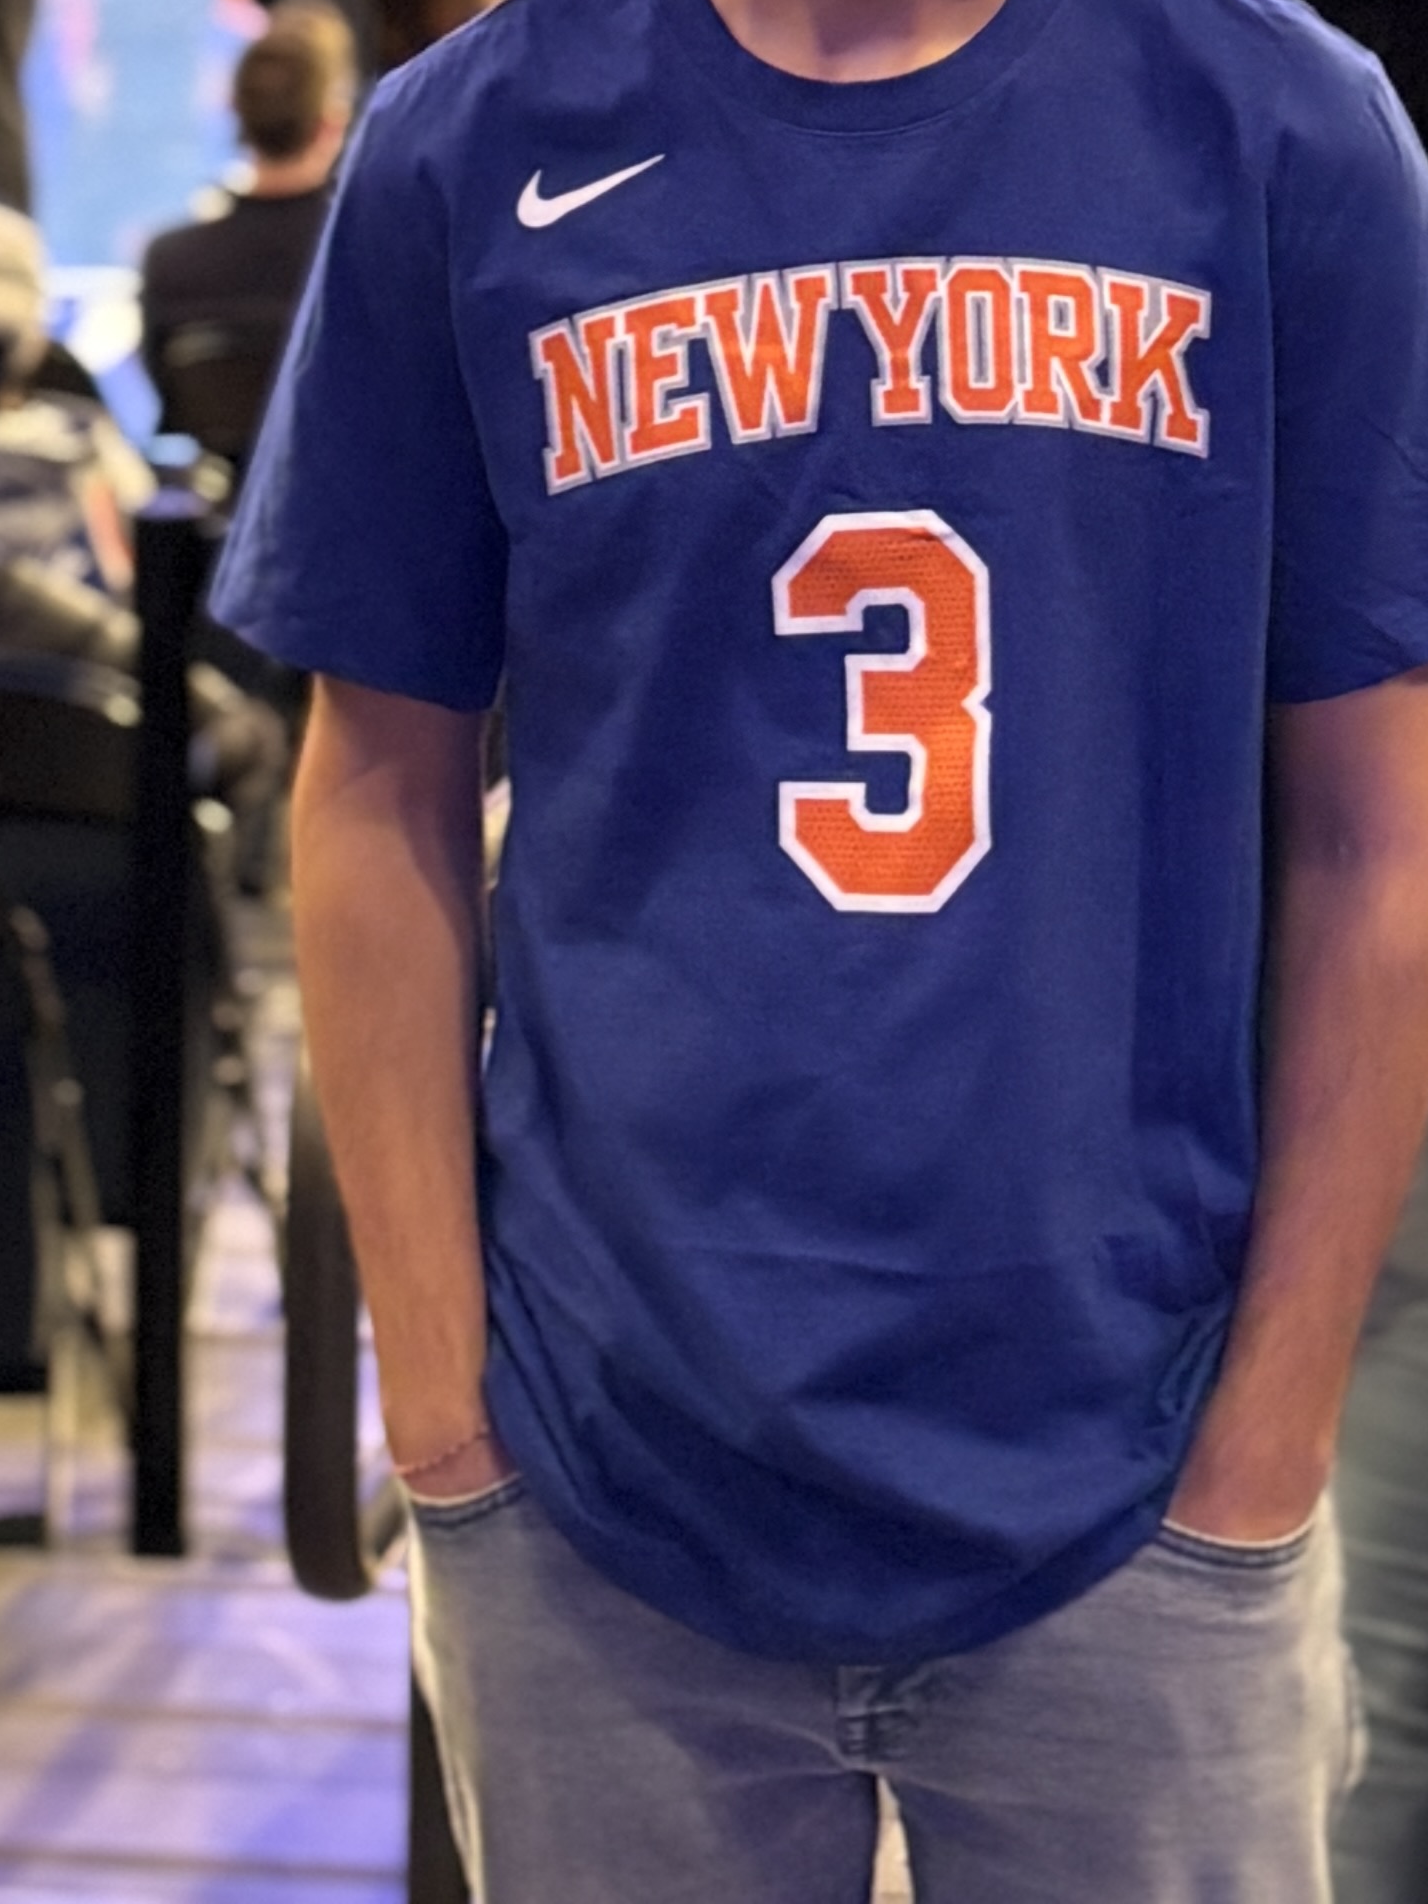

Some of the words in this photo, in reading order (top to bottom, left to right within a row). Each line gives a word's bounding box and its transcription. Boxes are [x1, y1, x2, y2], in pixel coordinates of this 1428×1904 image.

[529, 261, 839, 496] NEW
[838, 256, 1212, 459] YORK
[772, 509, 992, 913] 3
